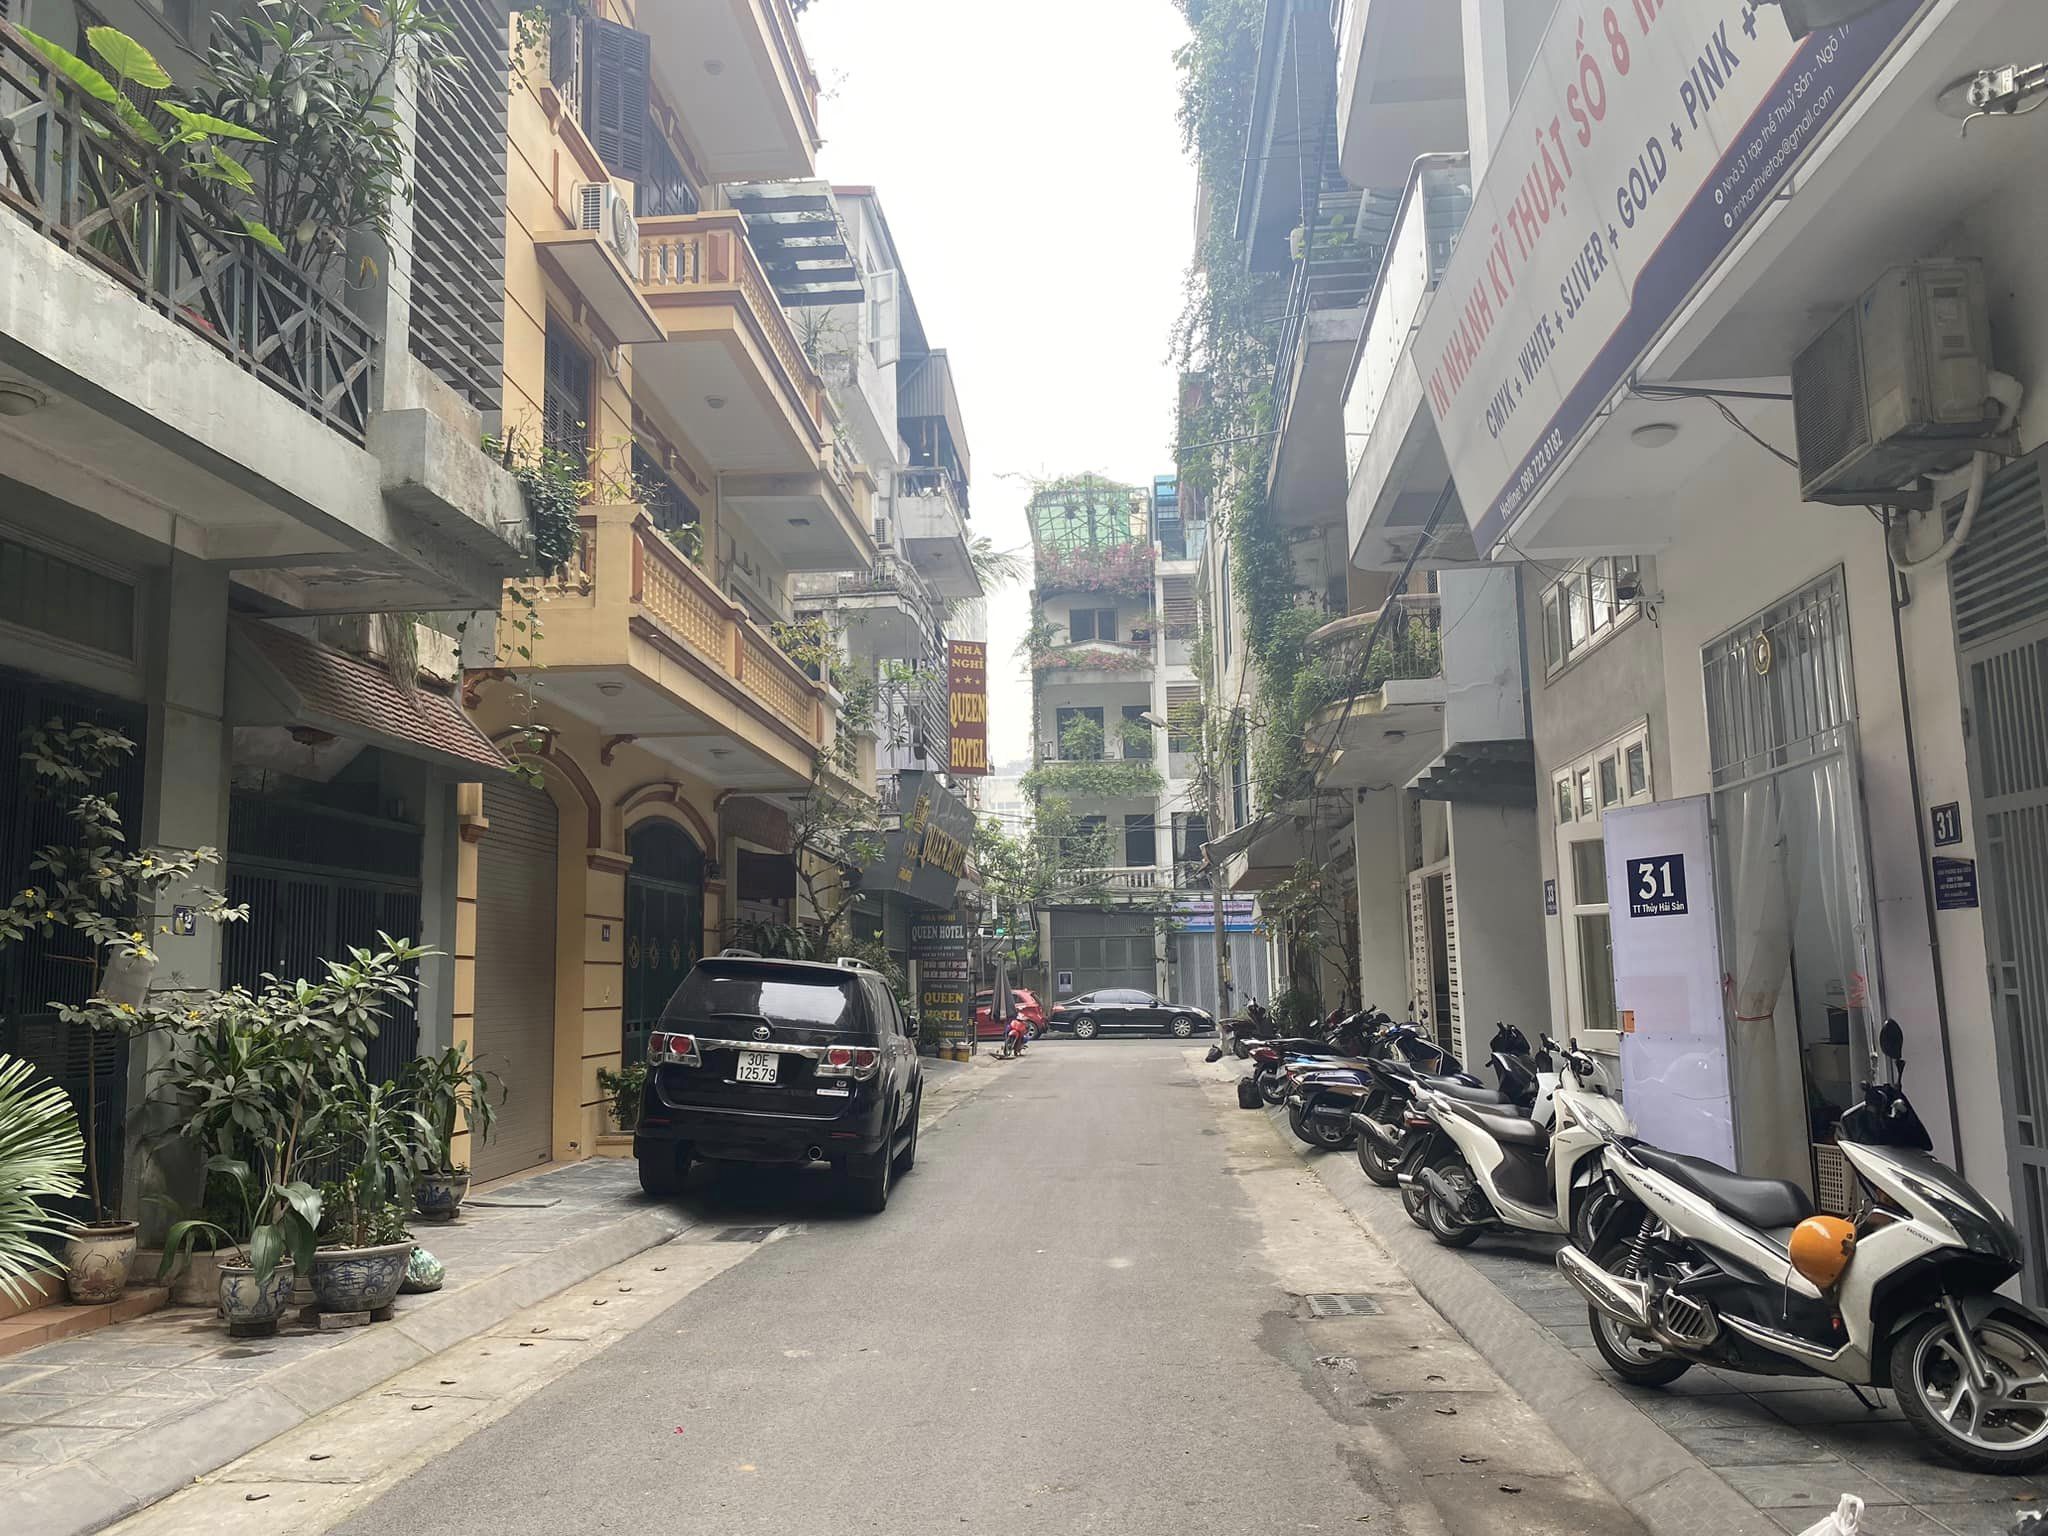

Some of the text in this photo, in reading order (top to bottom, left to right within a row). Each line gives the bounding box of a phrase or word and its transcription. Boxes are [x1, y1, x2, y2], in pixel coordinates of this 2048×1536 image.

[1722, 167, 1740, 195] Nhà
[1737, 154, 1749, 174] 31
[1816, 34, 1839, 69] Ngõ
[1428, 367, 1450, 423] IN
[1441, 277, 1495, 396] NHANH
[1506, 113, 1573, 262] THUẬT
[1566, 15, 1607, 148] SỐ
[1603, 6, 1631, 76] 8
[1486, 375, 1517, 440] CMYK
[1517, 313, 1556, 385] WHITE
[1559, 231, 1609, 320] SLIVER
[1616, 136, 1667, 229] GOLD
[1679, 19, 1741, 131] PINK
[953, 644, 983, 656] NHÀ
[950, 692, 986, 728] QUEEN
[951, 737, 986, 768] HOTEL
[1936, 809, 1954, 840] 31
[1638, 861, 1675, 900] 31
[1632, 904, 1641, 914] TT
[912, 924, 965, 942] QUEEN HOTEL
[924, 992, 964, 1006] QUEEN
[740, 1067, 776, 1081] 125.79
[748, 1053, 770, 1068] 30E
